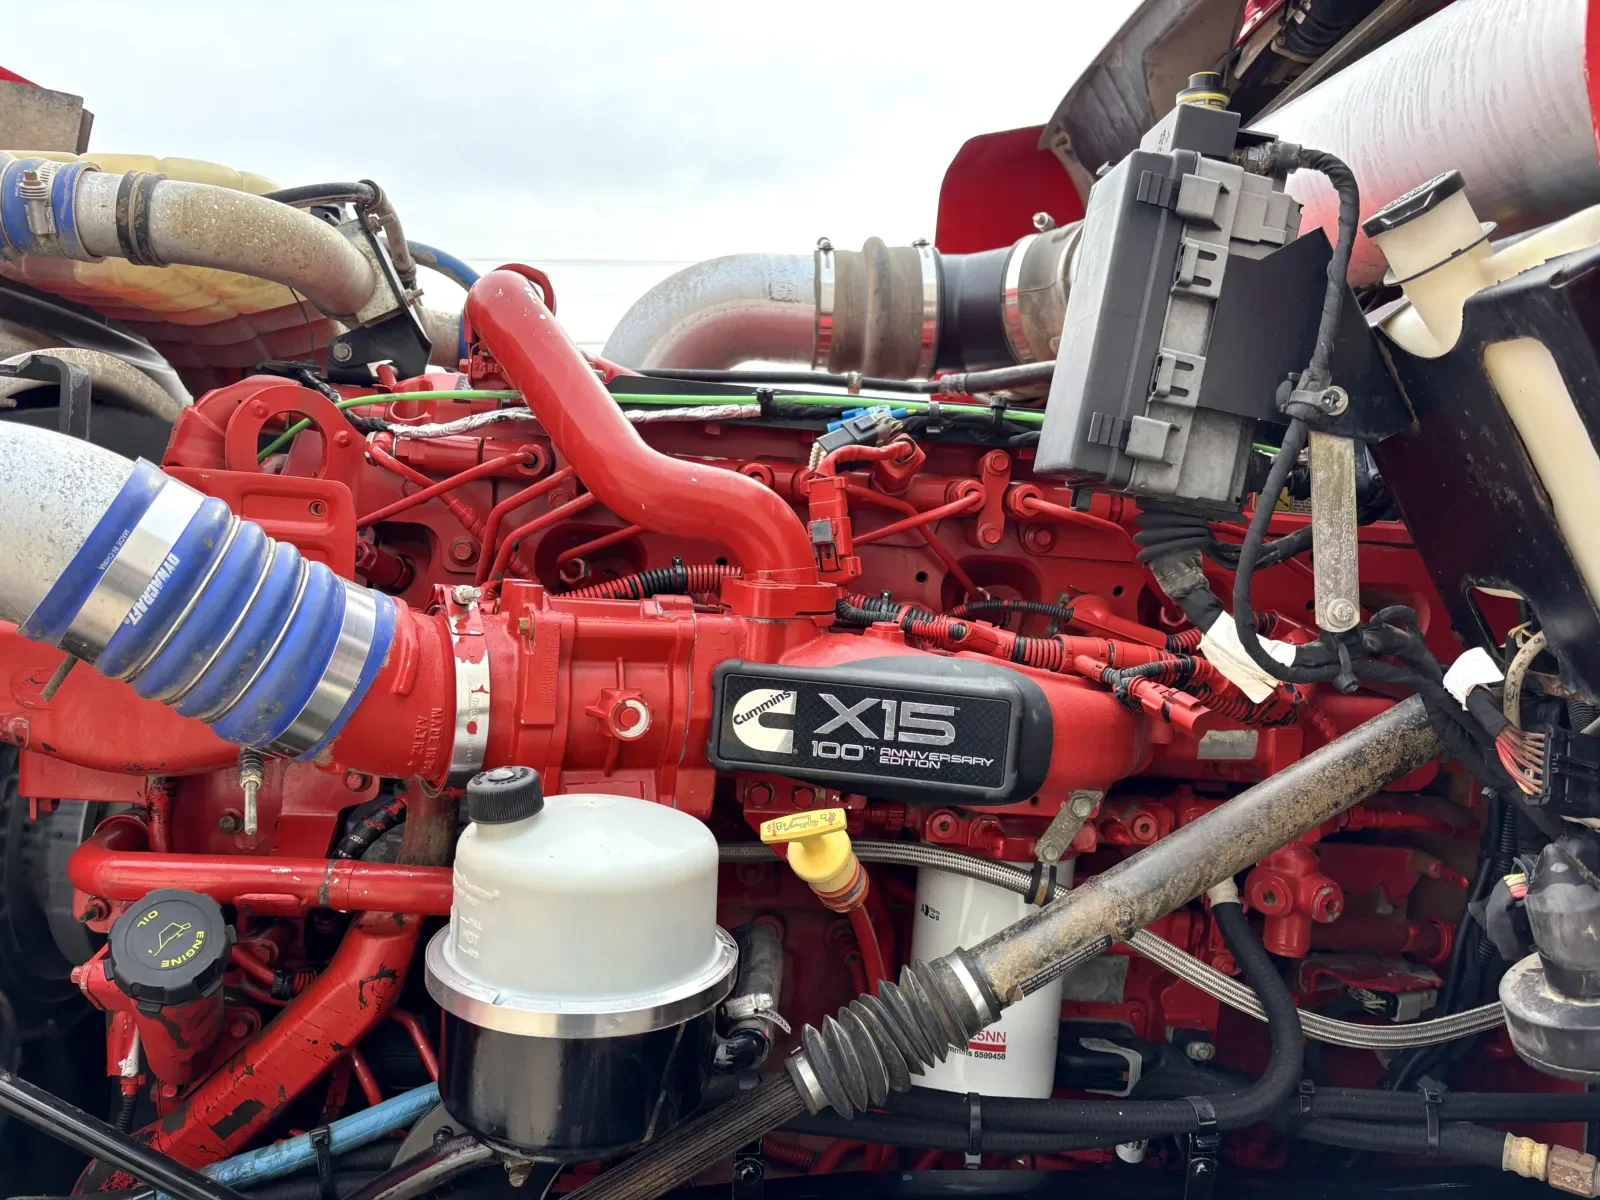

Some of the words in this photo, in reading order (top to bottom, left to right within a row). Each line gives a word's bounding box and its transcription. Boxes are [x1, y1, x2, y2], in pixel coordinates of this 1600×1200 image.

[116, 529, 130, 547] MADE
[98, 552, 115, 571] CHINA
[733, 690, 792, 726] Cummins
[428, 707, 443, 744] MADE
[813, 693, 956, 747] X15
[879, 747, 995, 768] ANNIVERSARY
[879, 756, 942, 770] EDITION
[137, 910, 159, 928] OIL
[160, 930, 205, 968] ENGINE
[971, 1030, 1007, 1043] 5NN
[974, 1050, 1007, 1061] 5599456
